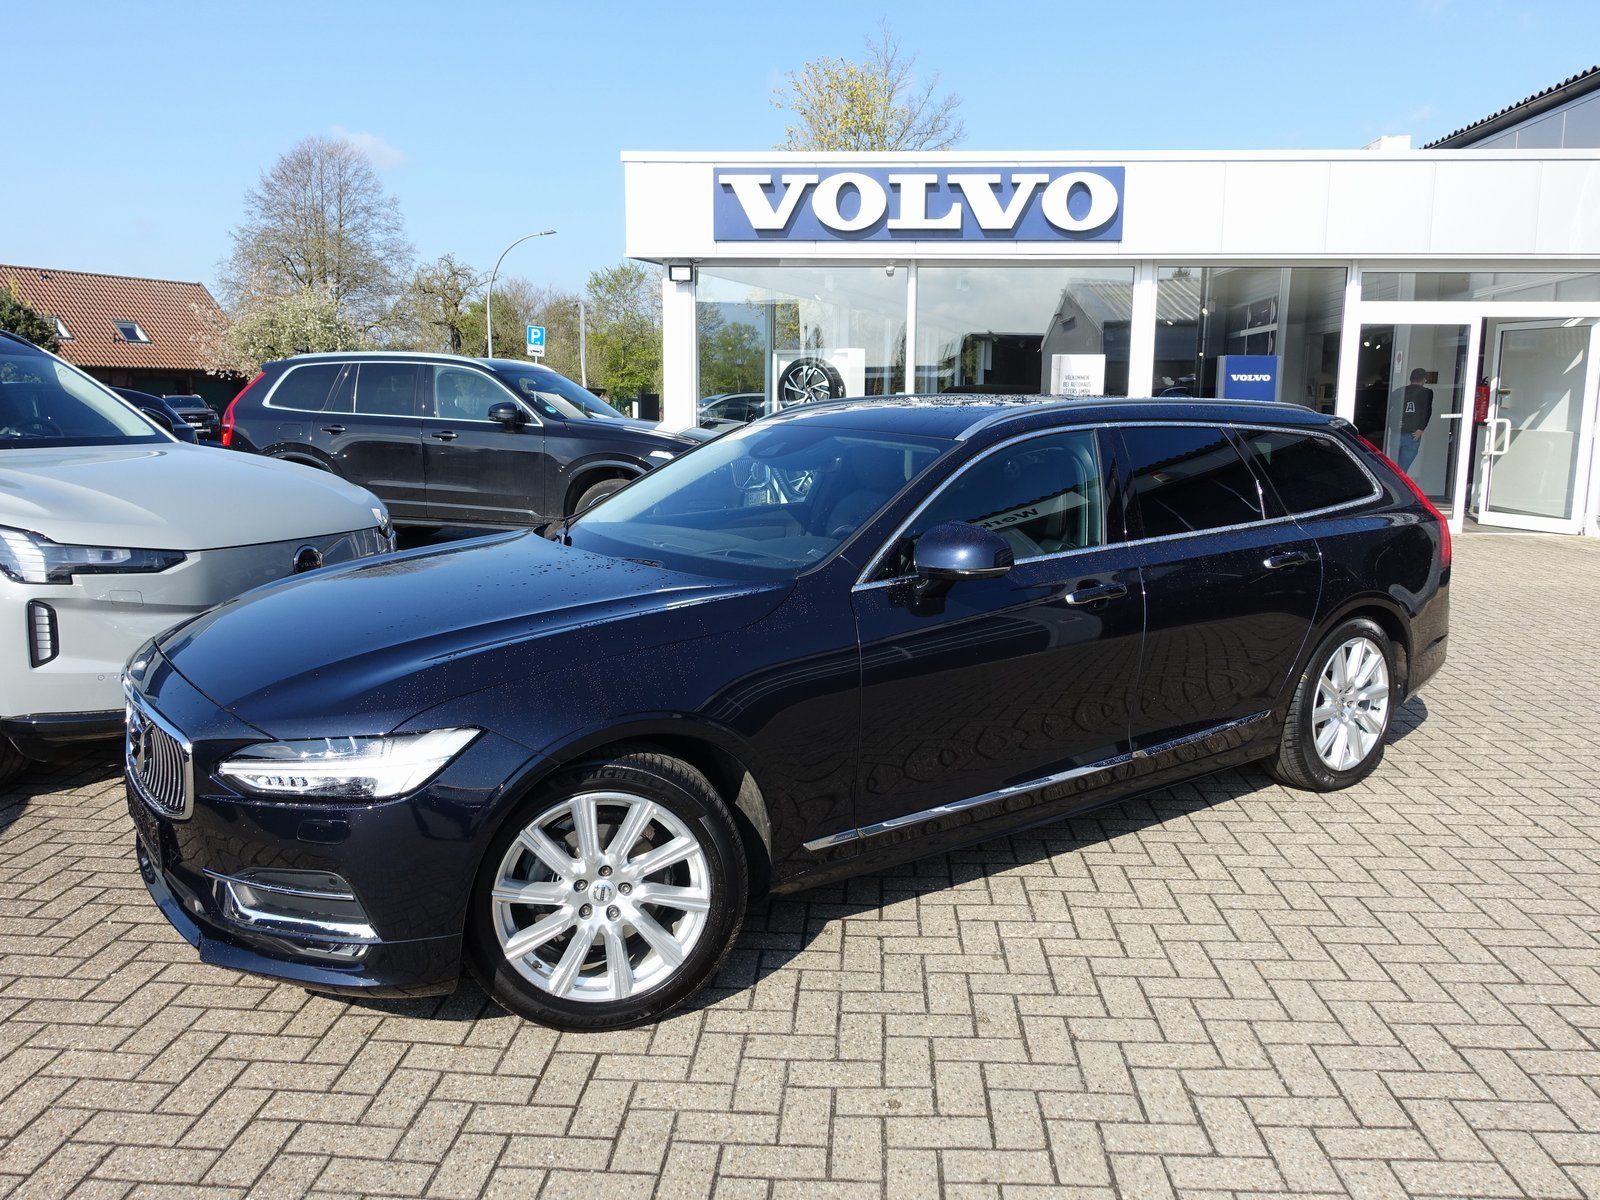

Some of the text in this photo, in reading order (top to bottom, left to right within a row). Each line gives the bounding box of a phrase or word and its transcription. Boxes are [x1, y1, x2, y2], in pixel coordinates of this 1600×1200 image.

[718, 172, 1118, 231] VOLVO
[531, 329, 541, 343] P
[1231, 374, 1271, 382] VOLVO
[1405, 401, 1415, 413] A
